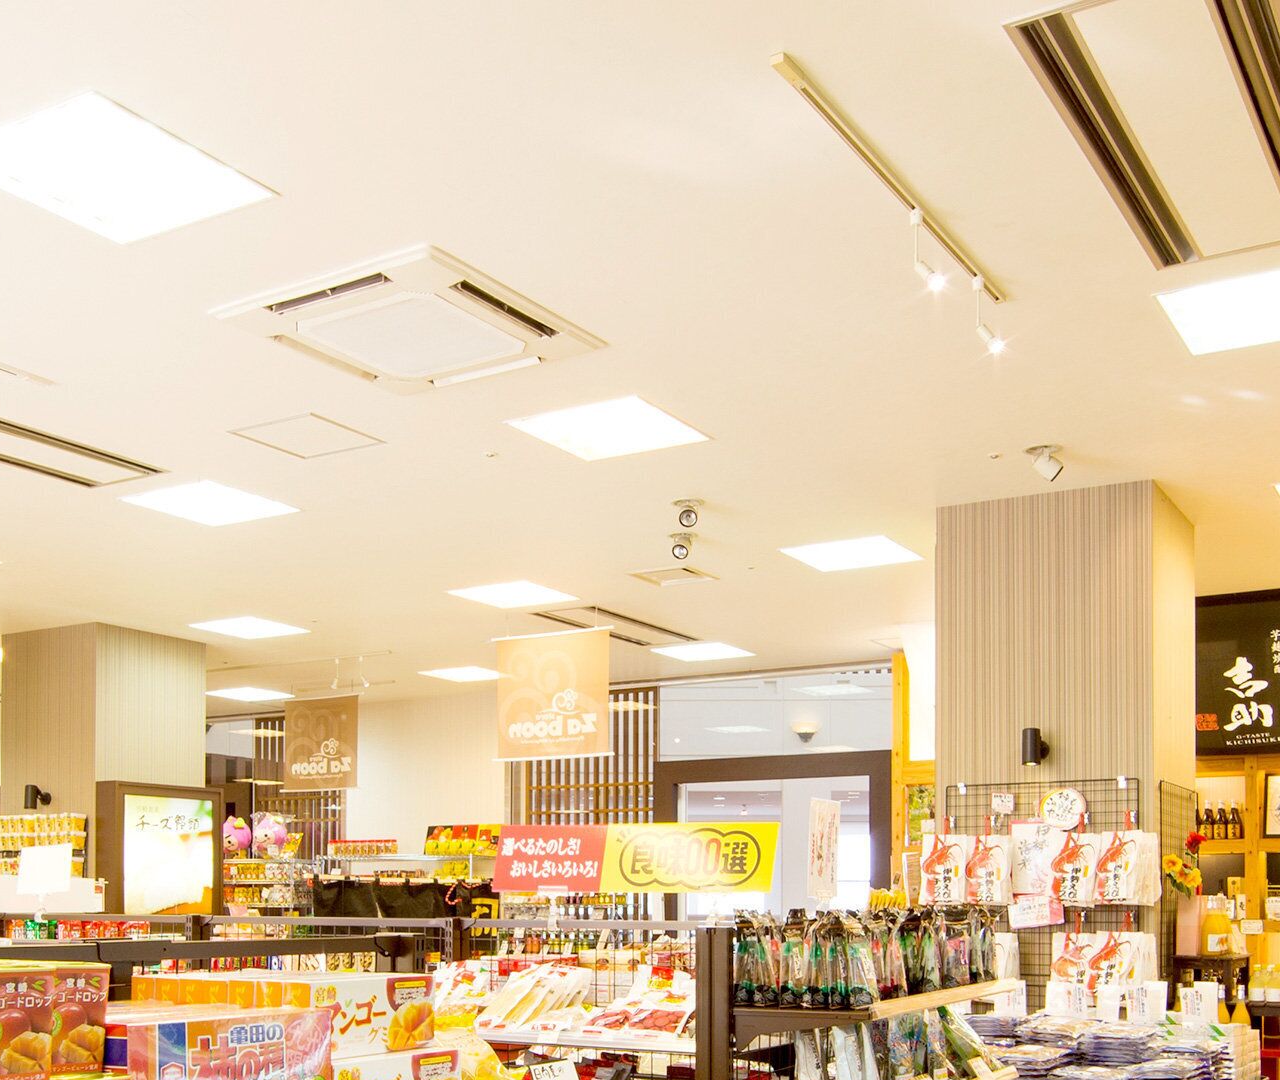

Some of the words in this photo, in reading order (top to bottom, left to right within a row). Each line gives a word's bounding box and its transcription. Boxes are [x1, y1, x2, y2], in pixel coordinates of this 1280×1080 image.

[1223, 656, 1274, 732] 吉助
[54, 991, 108, 1004] ゴードロップ
